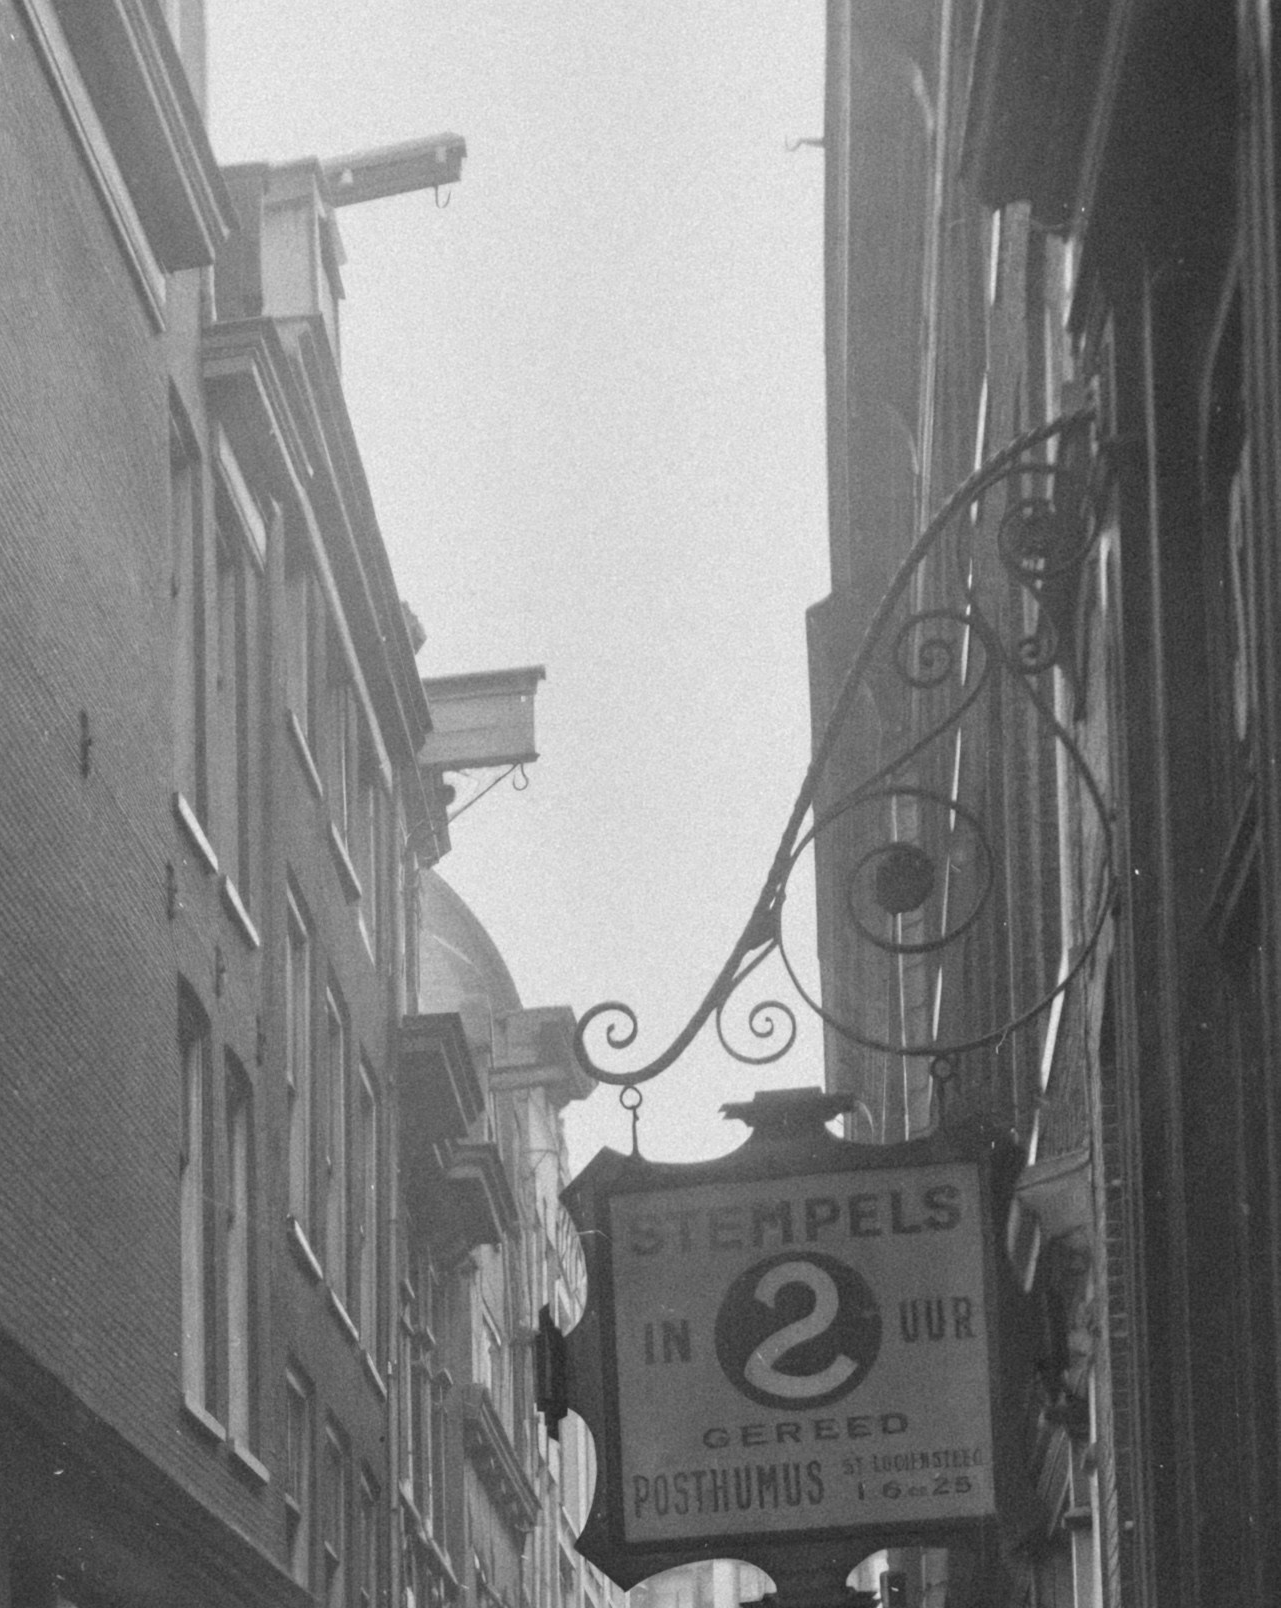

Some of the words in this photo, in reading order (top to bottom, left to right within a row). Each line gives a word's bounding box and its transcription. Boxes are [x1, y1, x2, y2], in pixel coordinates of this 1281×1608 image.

[629, 1183, 963, 1257] STEMPELS
[644, 1319, 691, 1365] IN
[743, 1260, 859, 1399] 2
[898, 1295, 977, 1344] UUR
[702, 1412, 909, 1450] GEREED
[633, 1459, 825, 1519] POSTHUMUS
